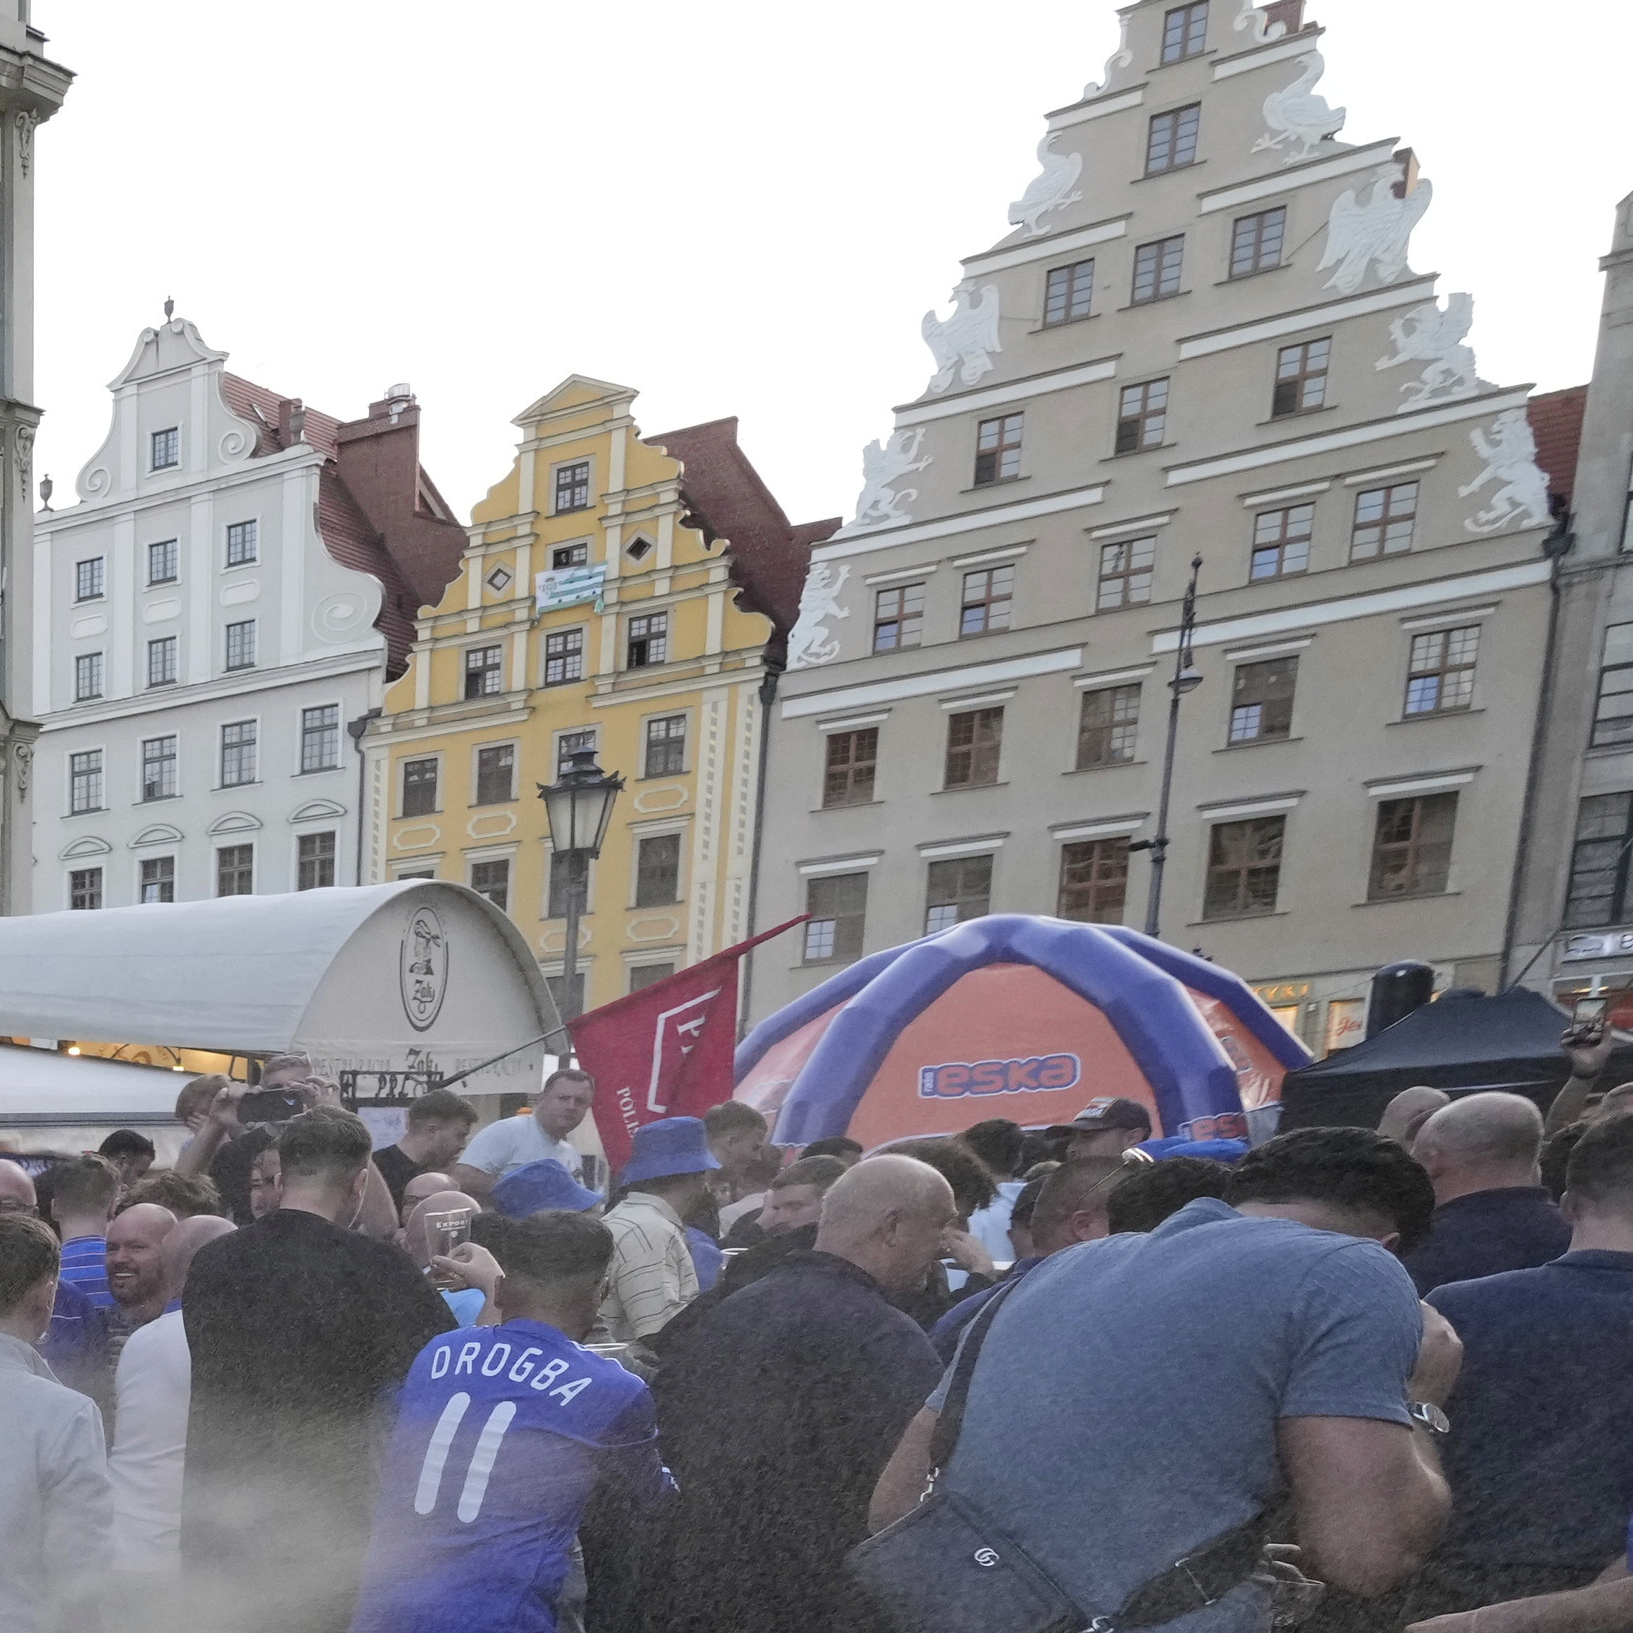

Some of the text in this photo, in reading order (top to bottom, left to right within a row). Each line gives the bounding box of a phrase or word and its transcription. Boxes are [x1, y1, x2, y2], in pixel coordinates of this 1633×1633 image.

[937, 1055, 1075, 1094] eska
[431, 1341, 592, 1407] DROGBA
[414, 1391, 517, 1523] 11
